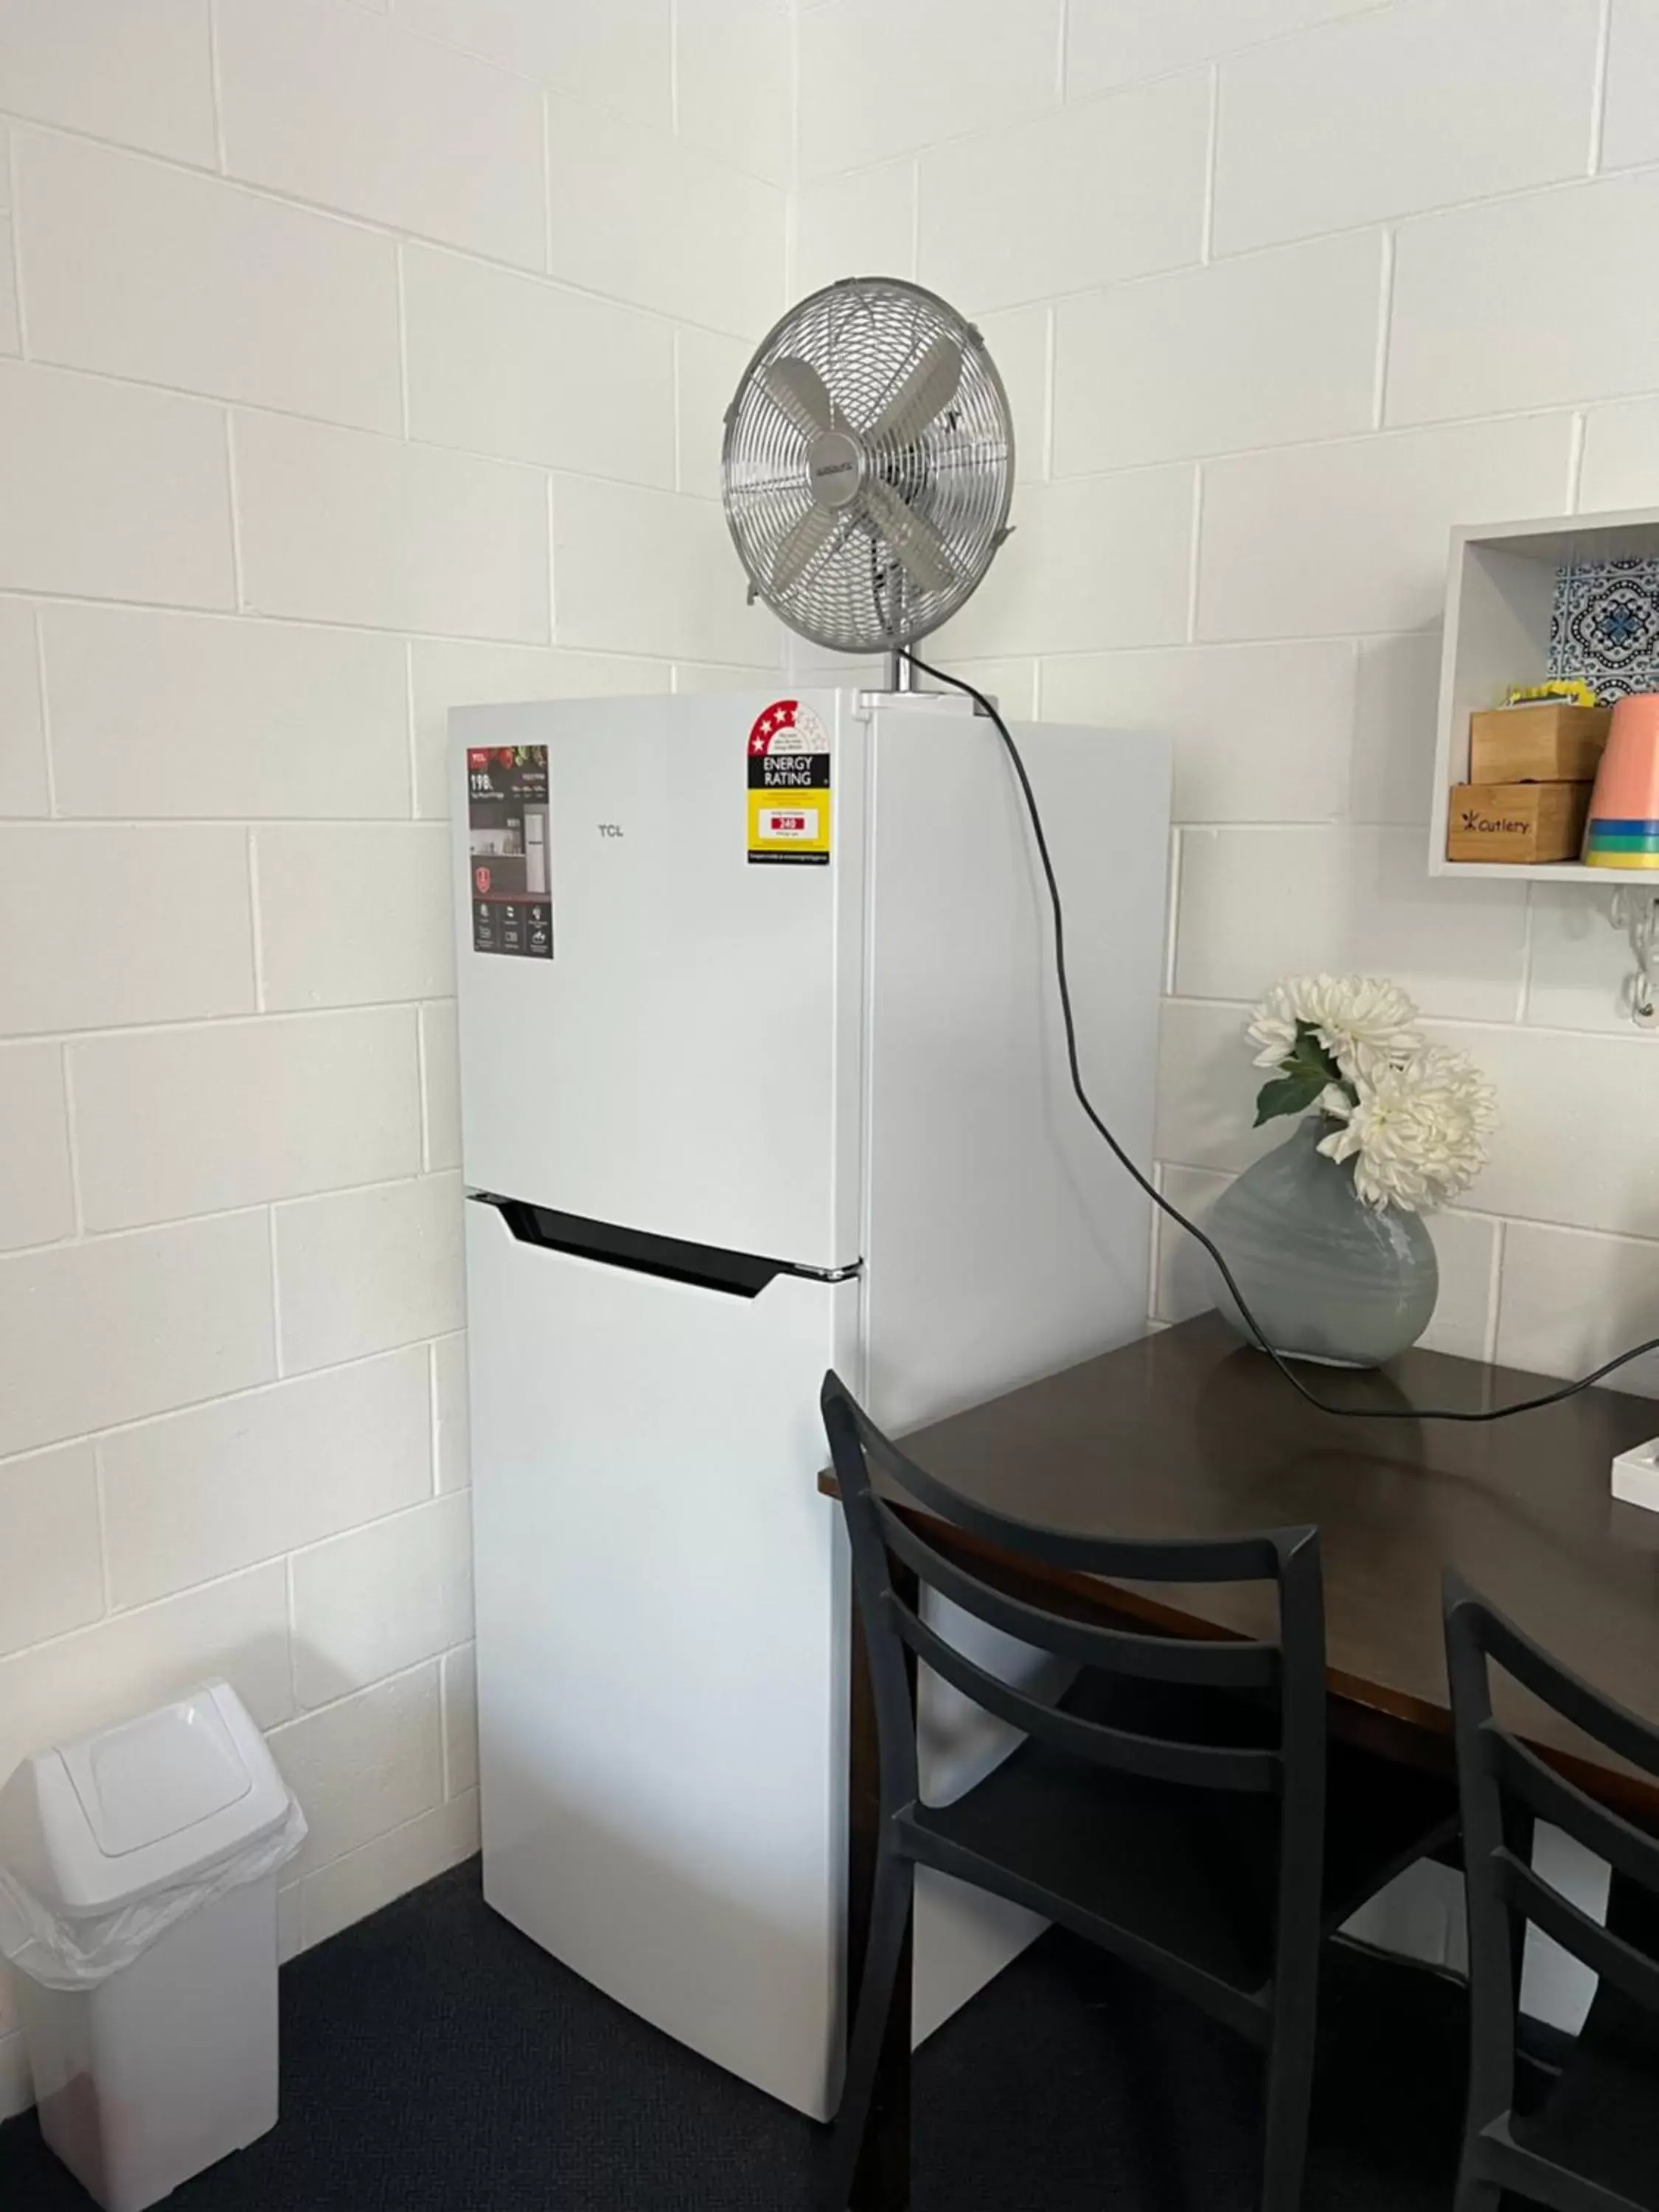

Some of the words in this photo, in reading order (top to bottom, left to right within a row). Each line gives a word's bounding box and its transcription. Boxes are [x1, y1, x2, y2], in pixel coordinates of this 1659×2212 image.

[764, 757, 813, 771] ENERGY
[765, 771, 811, 786] RATING
[598, 824, 624, 838] TCL
[1478, 818, 1529, 835] Cutlery
